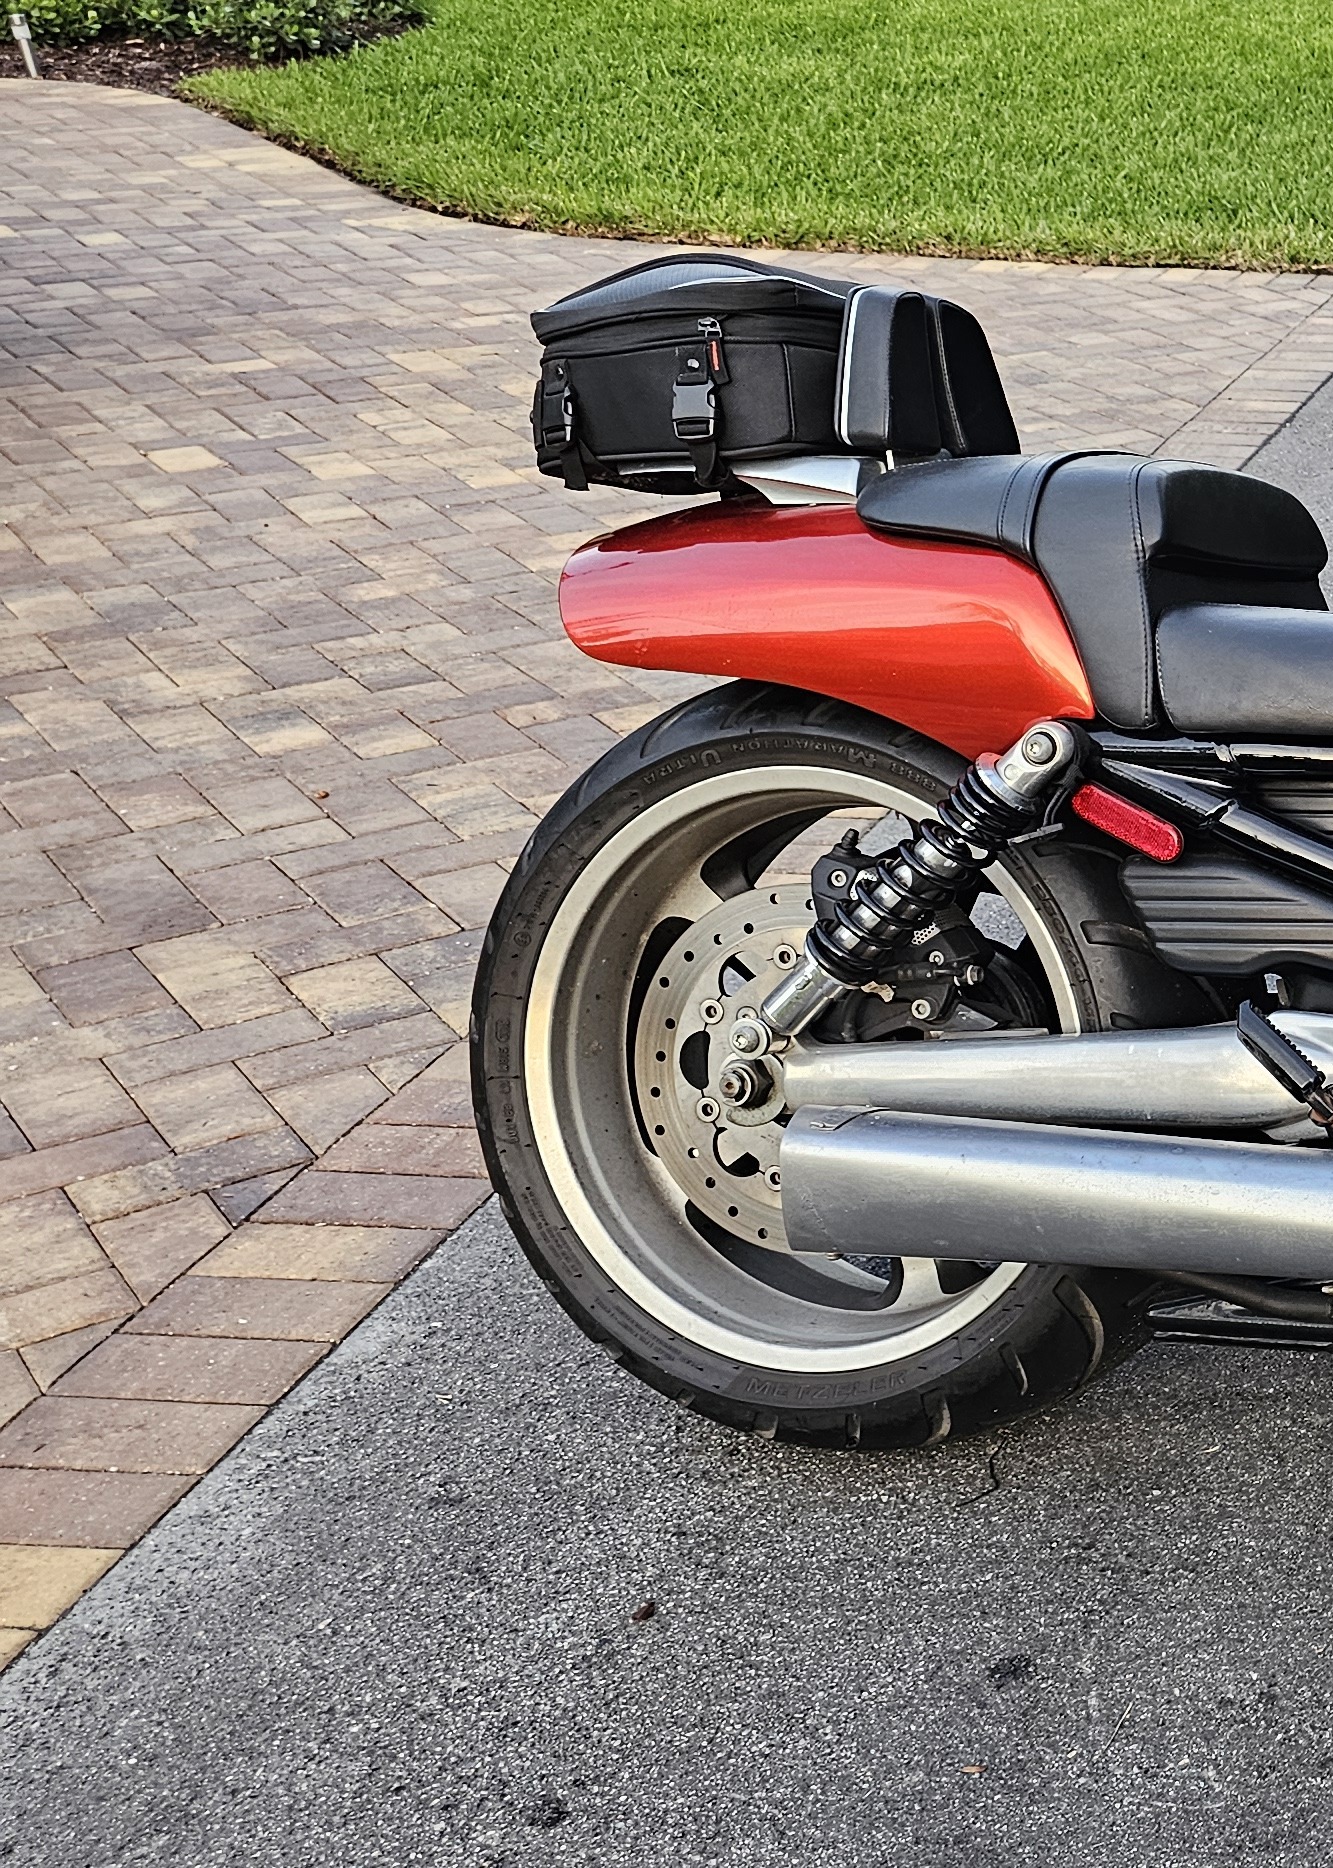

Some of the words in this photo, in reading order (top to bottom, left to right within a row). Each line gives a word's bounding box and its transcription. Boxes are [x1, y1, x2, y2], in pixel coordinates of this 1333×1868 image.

[642, 749, 723, 785] ULTRA
[731, 737, 877, 768] MARATHON
[888, 760, 937, 792] 888
[746, 1369, 908, 1399] METZELER
